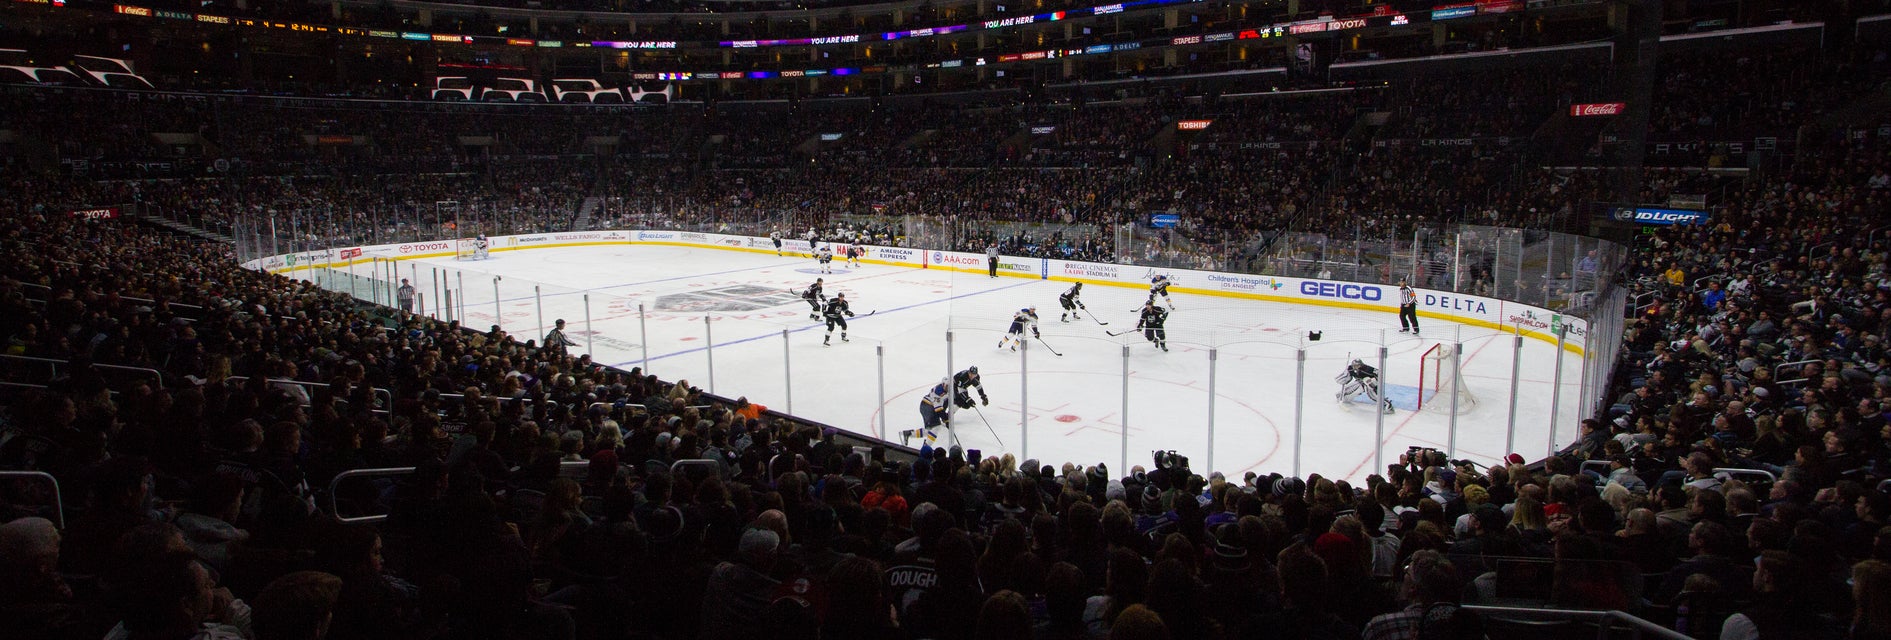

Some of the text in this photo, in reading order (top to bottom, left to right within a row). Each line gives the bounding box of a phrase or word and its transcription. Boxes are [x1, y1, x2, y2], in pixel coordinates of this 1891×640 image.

[164, 11, 192, 20] DELTA
[197, 14, 229, 24] STAPLES
[984, 15, 1034, 29] YOU ARE HERE
[1328, 18, 1366, 30] TOYOTA
[811, 37, 824, 45] YOU
[841, 35, 859, 43] HERE
[1173, 36, 1199, 45] STAPLES
[623, 41, 677, 49] YOU ARE HERE
[1021, 51, 1046, 60] TOSHIBA
[781, 70, 804, 78] TOYOTA
[1584, 103, 1616, 115] Coca-Cola
[1438, 138, 1472, 146] KINGS
[414, 243, 448, 252] TOYOTA
[880, 247, 913, 256] AMERICAN
[879, 253, 907, 261] EXPRESS
[943, 255, 979, 265] AAA.com
[1089, 264, 1118, 272] CINEMAS
[1086, 270, 1110, 278] STADIUM
[1207, 274, 1270, 286] Children's Hospital
[1300, 281, 1381, 301] GEICO
[1425, 294, 1486, 314] DELTA
